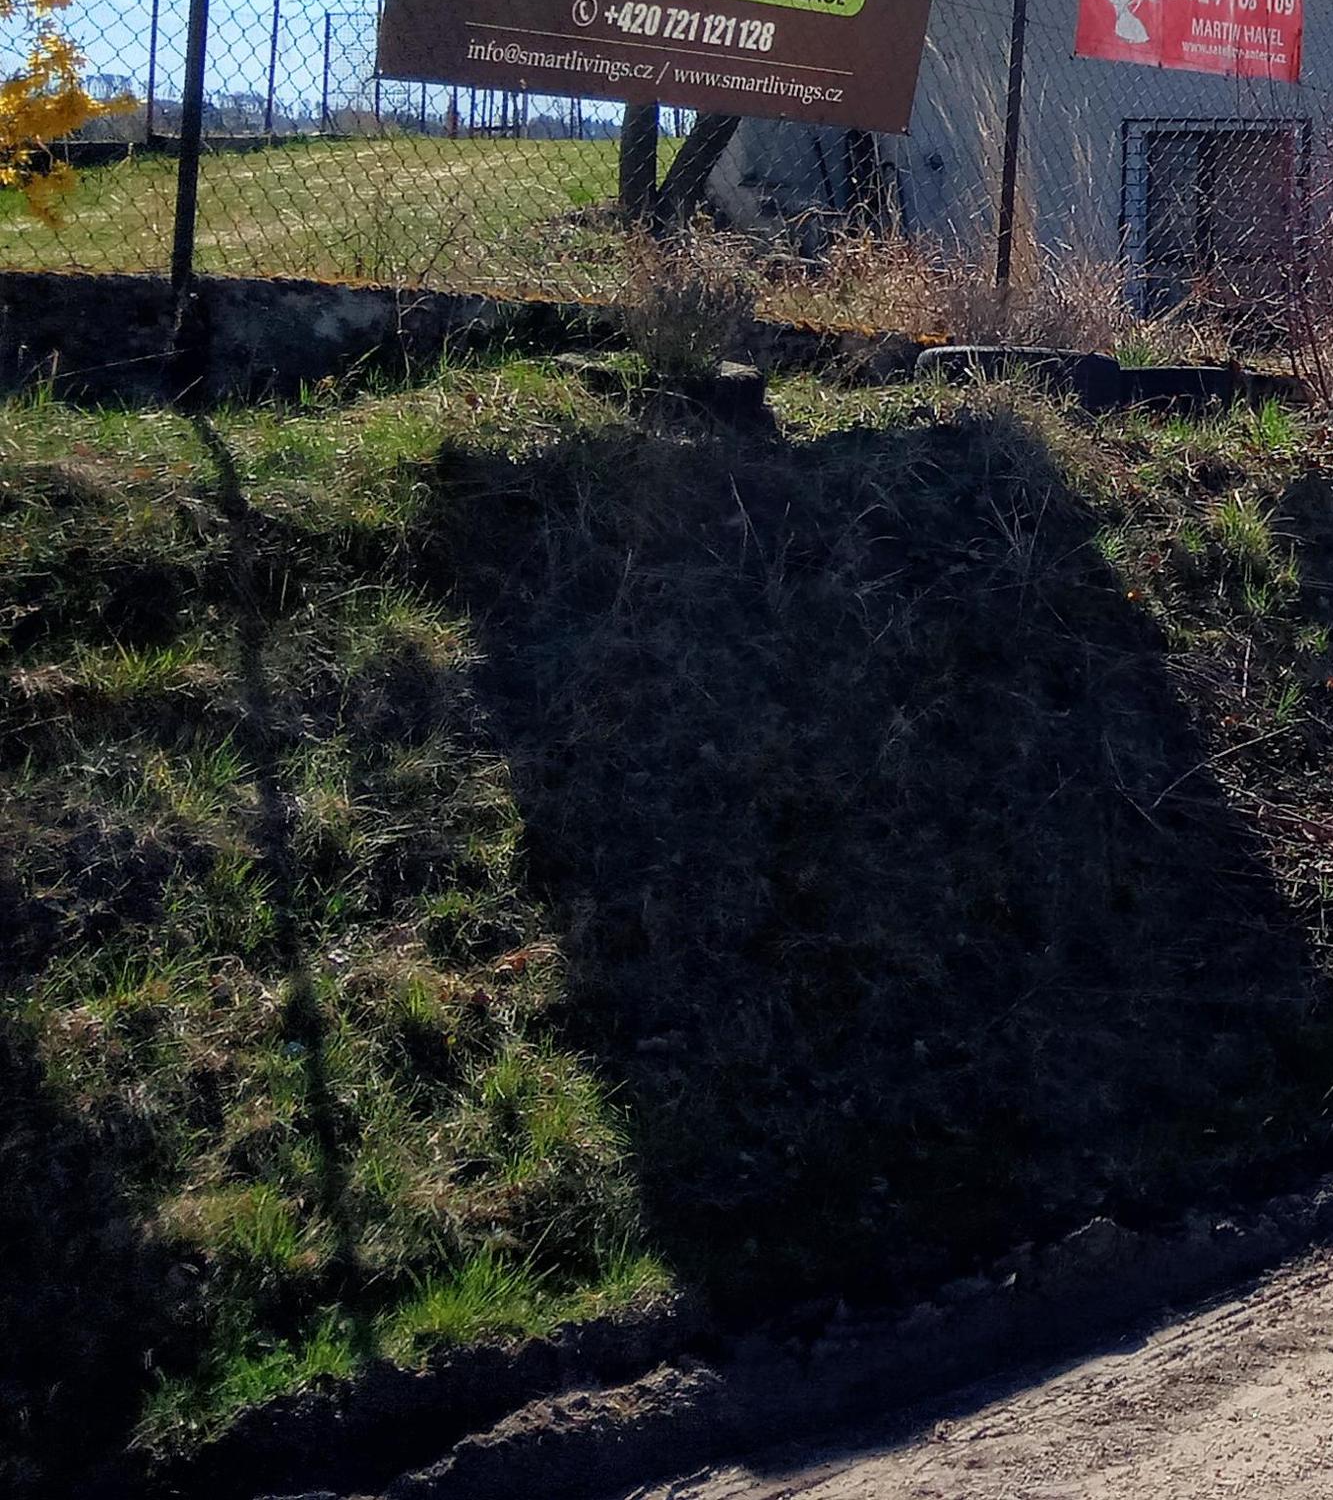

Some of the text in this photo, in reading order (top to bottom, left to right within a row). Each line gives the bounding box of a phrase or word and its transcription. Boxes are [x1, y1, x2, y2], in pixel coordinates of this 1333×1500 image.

[603, 1, 776, 52] +420 721 121 128
[1243, 25, 1285, 47] HAVEL
[466, 38, 655, 82] info@smartlivings.cz
[674, 67, 844, 105] www.smartlivings.cz
